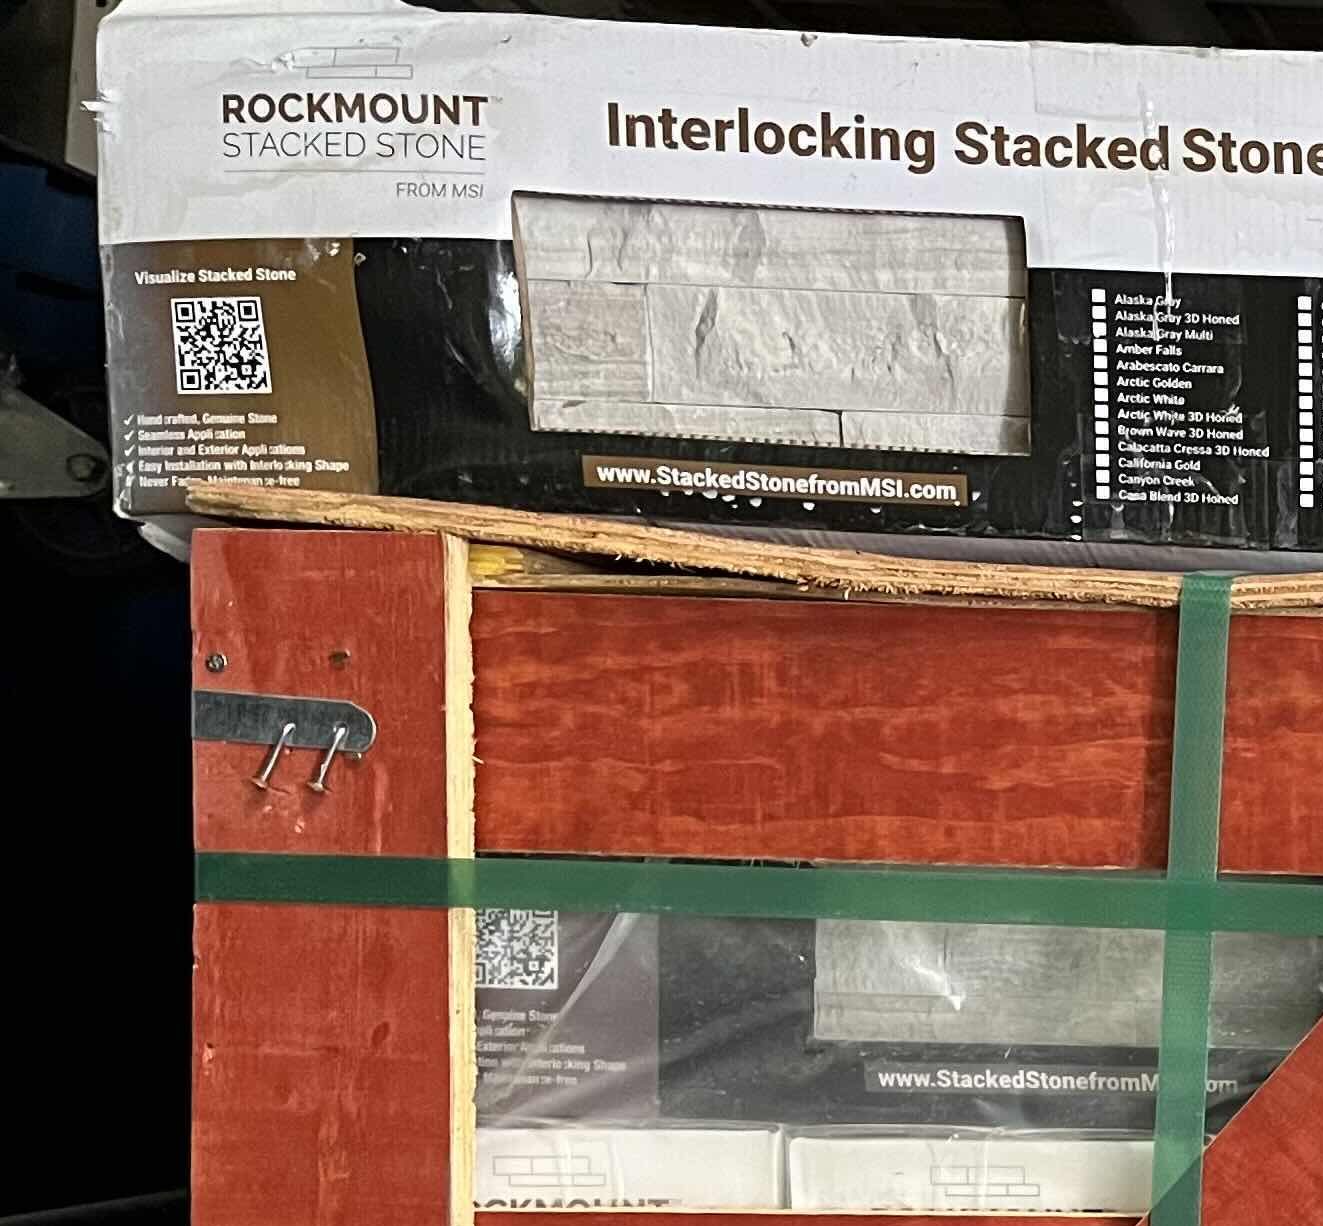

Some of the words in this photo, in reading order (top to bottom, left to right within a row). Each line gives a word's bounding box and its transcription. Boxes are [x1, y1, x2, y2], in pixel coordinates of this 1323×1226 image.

[222, 93, 489, 127] ROCKMOUNT
[607, 101, 937, 174] Interlocking
[953, 120, 1169, 171] Stacked
[222, 131, 366, 161] STACKED
[378, 133, 488, 163] STONE
[395, 182, 441, 197] FROM
[445, 183, 484, 199] MSI
[135, 270, 195, 285] Visualize
[198, 269, 252, 282] Stacked
[256, 268, 296, 281] Stone
[1115, 294, 1153, 305] Alaska
[1116, 344, 1152, 355] Amber
[1156, 345, 1182, 356] Falls
[1116, 360, 1180, 372] Arabescato
[1183, 363, 1224, 374] Carrara
[1117, 376, 1150, 387] Arctic
[1153, 378, 1192, 389] Golden
[202, 414, 244, 425] Genuine
[248, 414, 277, 424] Stone
[138, 445, 173, 456] Interior
[178, 446, 195, 456] and
[198, 444, 239, 456] Exterior
[139, 461, 162, 473] Easy
[165, 460, 221, 471] Installation
[224, 460, 247, 471] with
[315, 460, 349, 473] Shape
[1118, 458, 1172, 470] California
[1175, 459, 1200, 471] Gold
[597, 465, 957, 500] www.StackedStonefromMSI.com
[879, 1069, 1239, 1094] www.StackedStonefromMom
